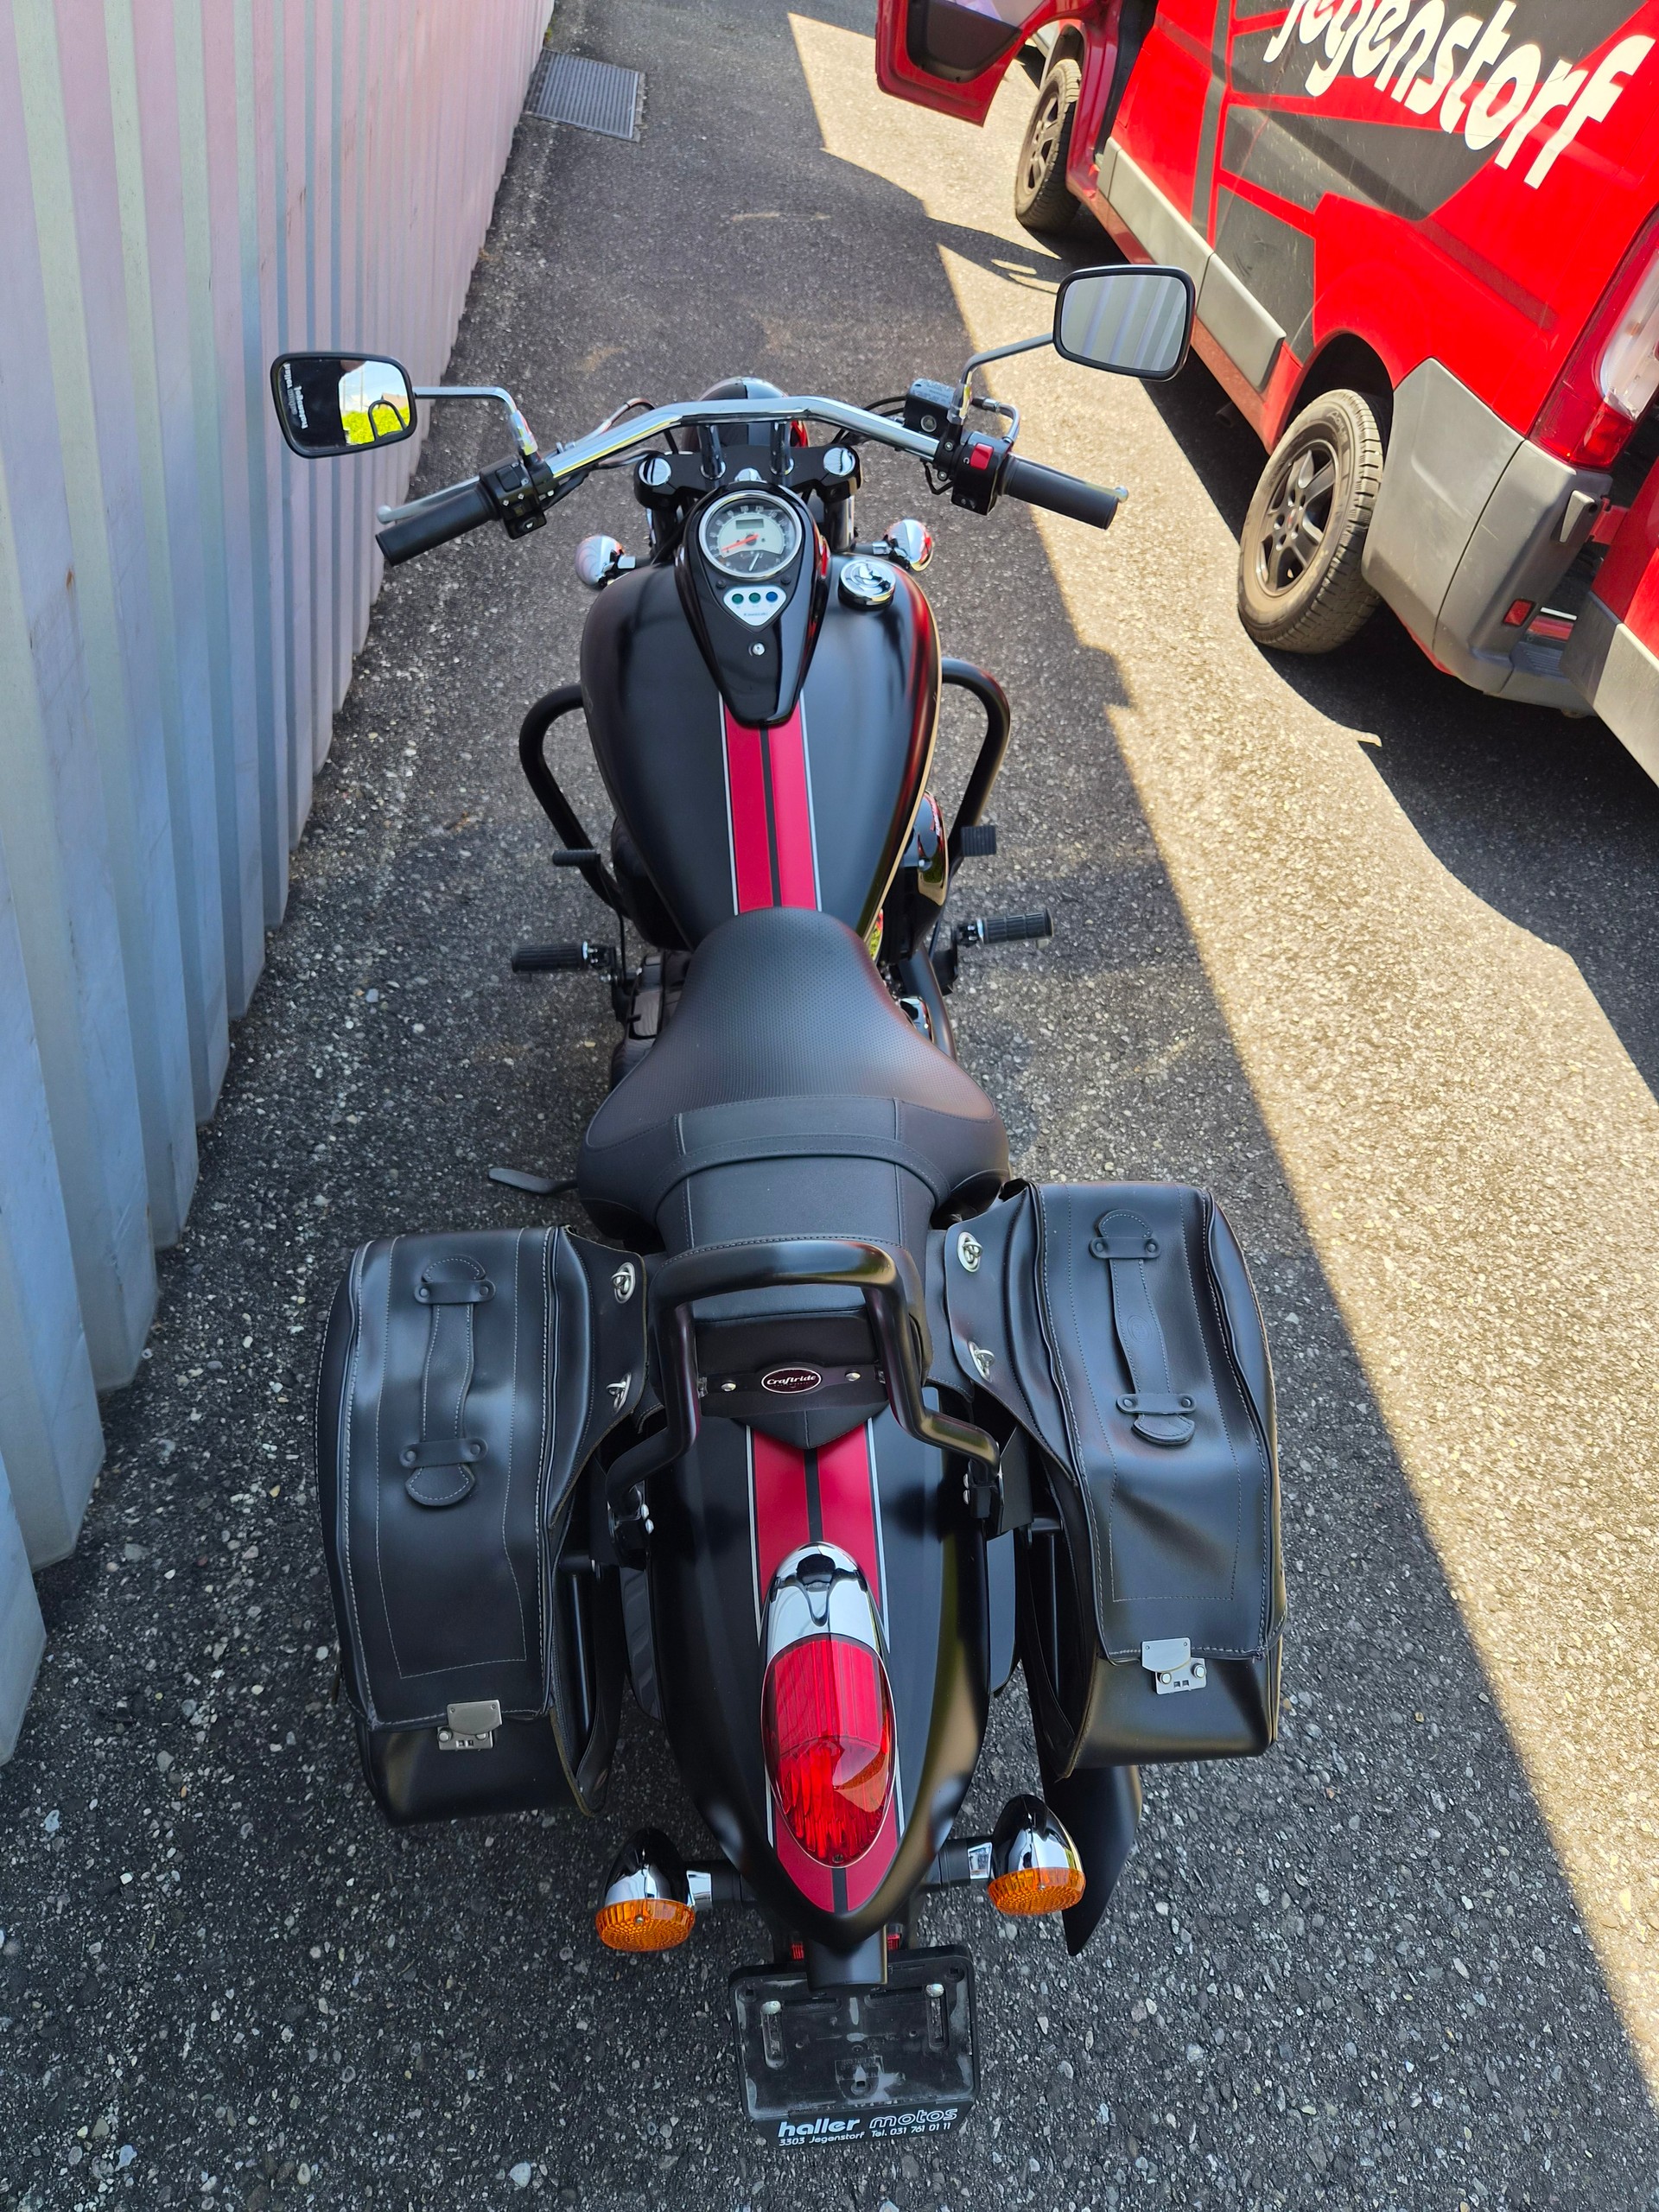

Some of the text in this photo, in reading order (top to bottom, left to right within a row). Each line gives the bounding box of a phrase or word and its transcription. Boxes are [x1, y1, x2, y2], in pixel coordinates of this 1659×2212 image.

[766, 1375, 817, 1384] Craftride
[779, 2108, 958, 2138] haller motos
[779, 2137, 805, 2146] 3303
[809, 2131, 865, 2144] Jegenstorf
[872, 2129, 887, 2138] Tel.
[890, 2126, 907, 2136] 031
[911, 2125, 925, 2133] 761
[929, 2122, 940, 2132] 01
